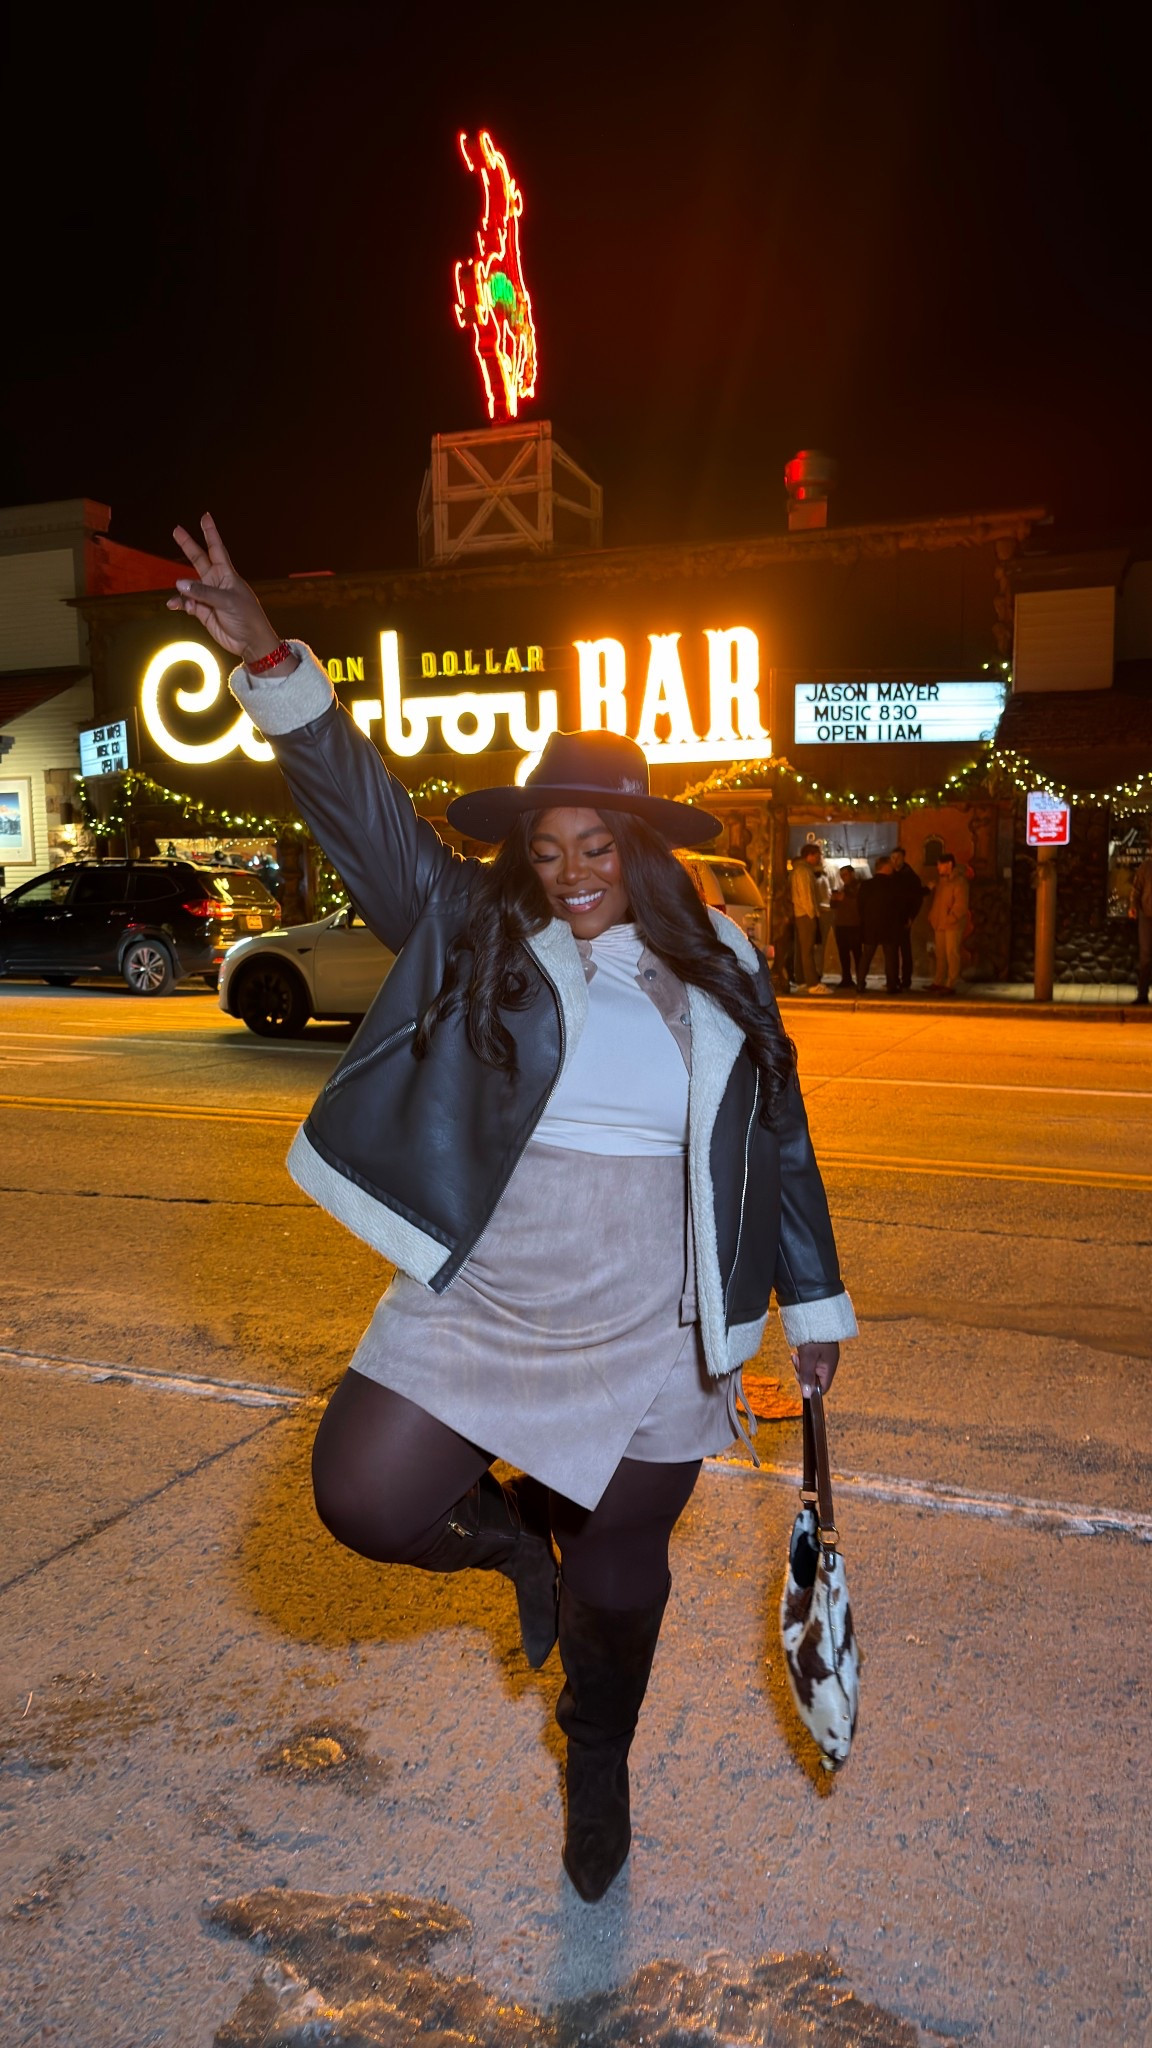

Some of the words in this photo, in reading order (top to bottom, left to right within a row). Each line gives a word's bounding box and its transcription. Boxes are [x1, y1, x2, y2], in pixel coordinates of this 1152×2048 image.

[421, 645, 545, 678] DOLLAR
[572, 626, 770, 742] BAR
[806, 683, 868, 701] JASON
[877, 683, 939, 701] MAYER
[814, 705, 871, 722] MUSIC
[879, 704, 917, 721] 830
[817, 725, 867, 740] OPEN
[877, 724, 922, 740] 11AM
